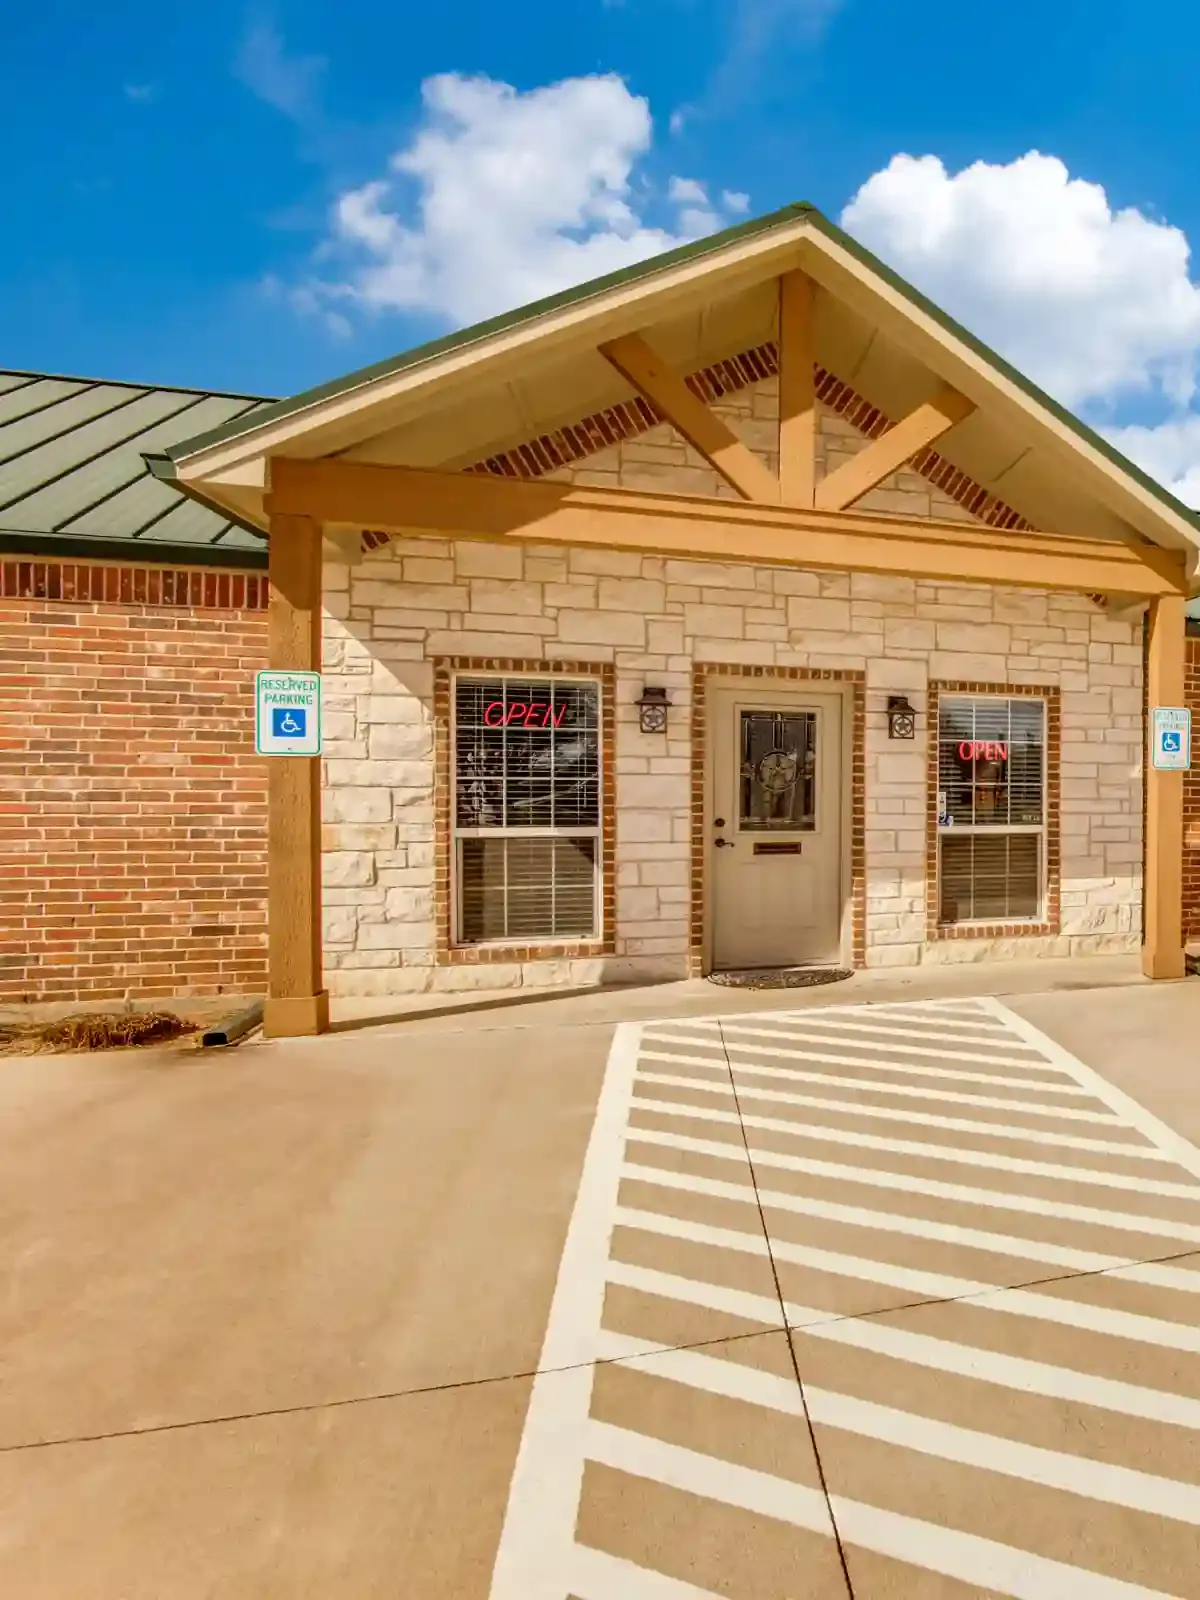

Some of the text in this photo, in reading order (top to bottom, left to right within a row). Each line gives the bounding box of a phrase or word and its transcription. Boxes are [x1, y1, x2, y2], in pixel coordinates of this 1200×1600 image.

[261, 679, 317, 691] RESERVED
[264, 693, 313, 705] PARKING
[484, 701, 567, 728] OPEN
[959, 741, 1008, 760] OPEN
